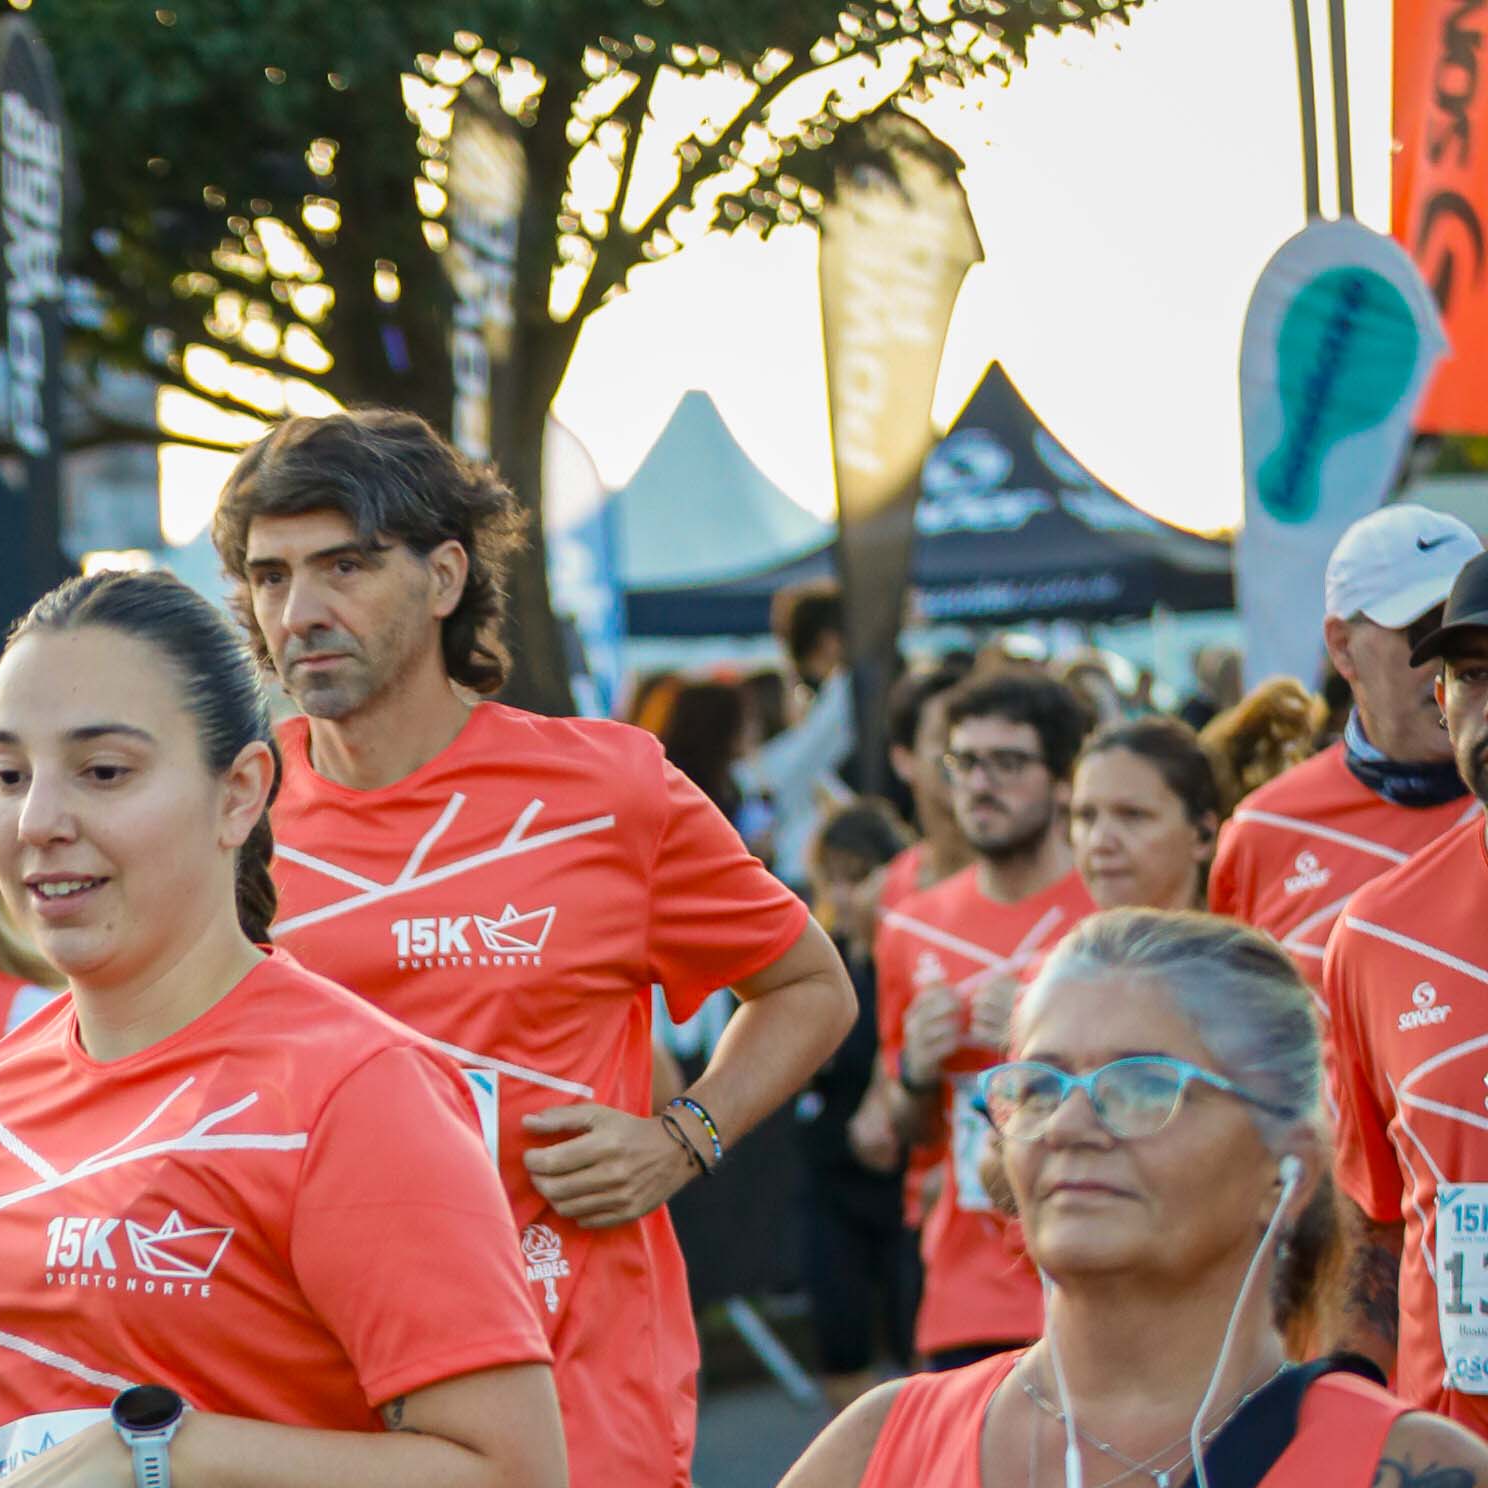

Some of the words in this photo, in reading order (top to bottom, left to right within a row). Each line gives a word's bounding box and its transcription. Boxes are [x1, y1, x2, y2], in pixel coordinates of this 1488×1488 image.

[391, 915, 472, 958] 15K
[398, 955, 472, 970] PUERTO
[479, 954, 542, 967] NORTE
[46, 1215, 121, 1270] 15K
[45, 1272, 117, 1289] PUERTO
[126, 1278, 211, 1298] NORTE
[526, 1259, 570, 1282] ARDEC
[1444, 1251, 1488, 1315] 1
